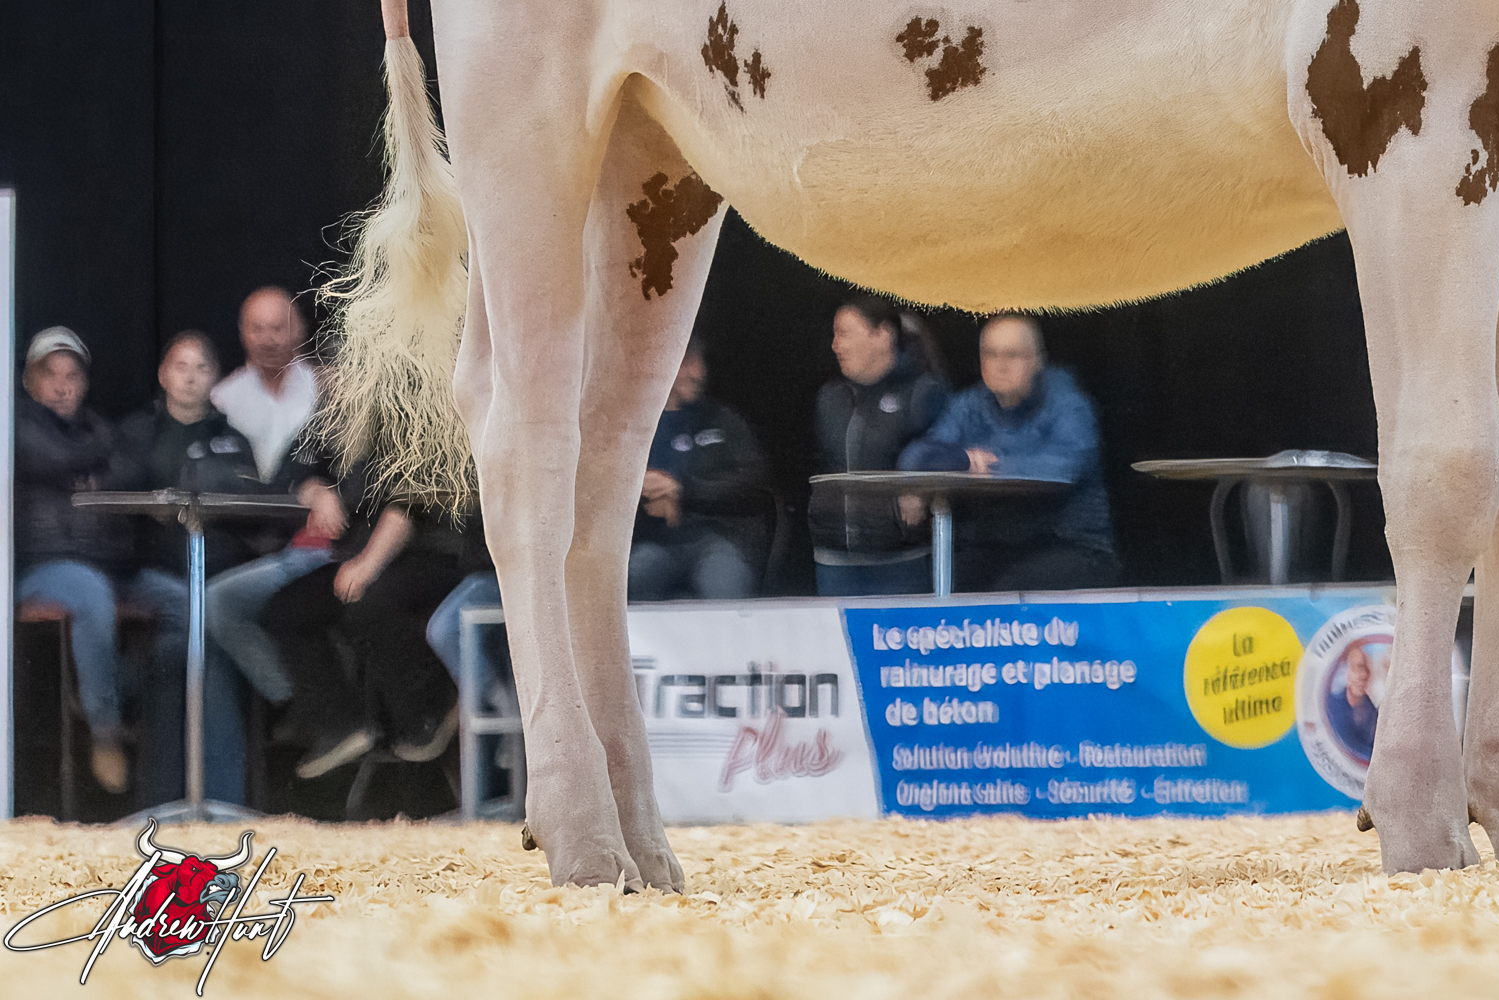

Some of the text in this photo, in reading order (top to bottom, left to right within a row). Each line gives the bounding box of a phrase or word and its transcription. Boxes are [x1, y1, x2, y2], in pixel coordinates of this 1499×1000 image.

[873, 623, 902, 650] Le
[906, 618, 1040, 655] spécialiste
[1232, 633, 1254, 657] La
[880, 658, 997, 692] rainurage
[1002, 660, 1028, 684] et
[885, 696, 1000, 726] de béton
[718, 705, 843, 792] Plus
